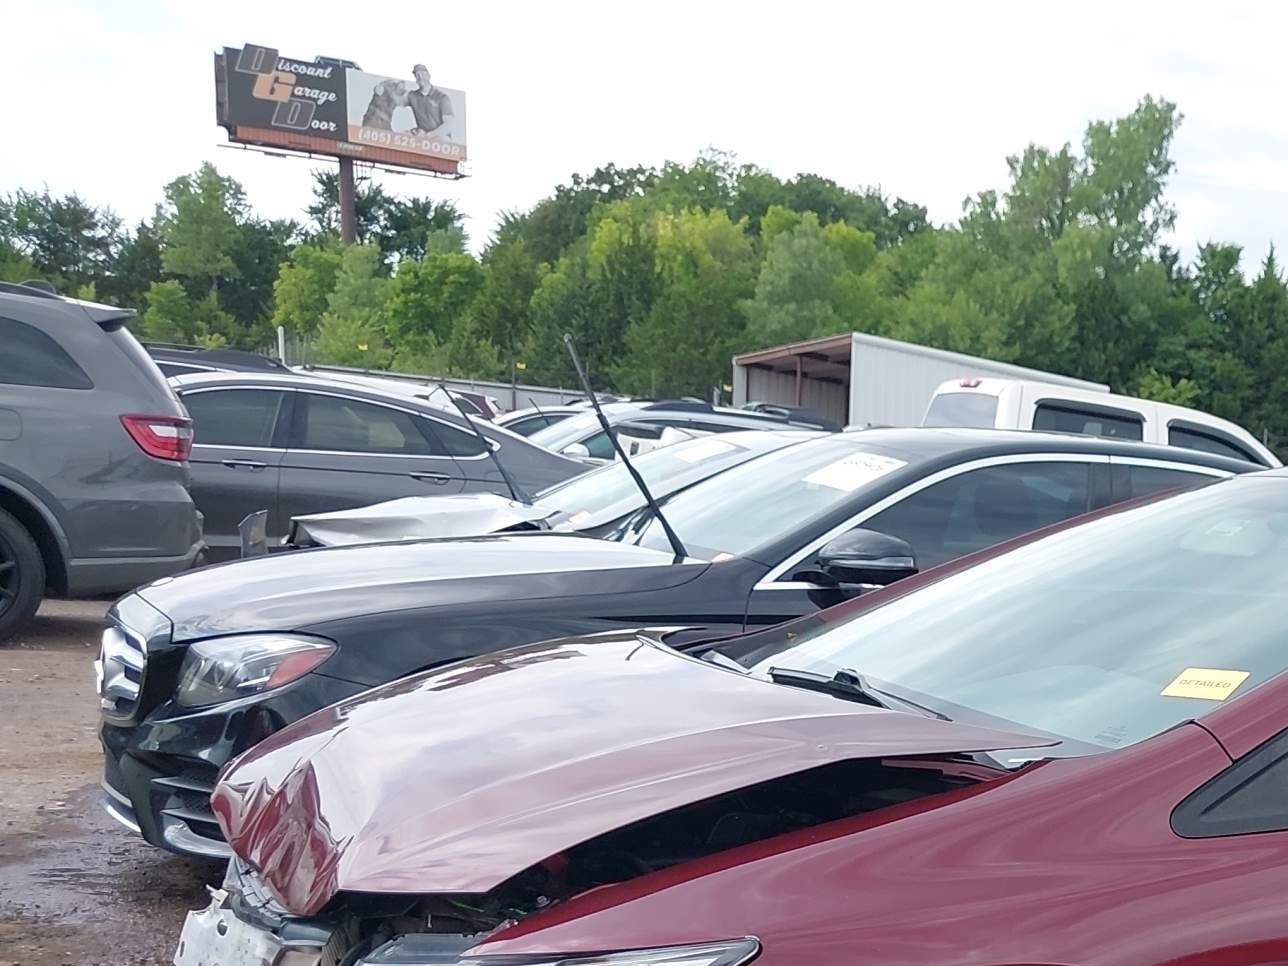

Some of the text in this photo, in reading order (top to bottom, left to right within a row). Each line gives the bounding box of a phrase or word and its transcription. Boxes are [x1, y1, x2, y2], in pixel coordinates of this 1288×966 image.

[235, 43, 333, 79] Discount
[253, 71, 338, 103] Garage
[271, 97, 337, 131] Door
[358, 128, 391, 145] (405)
